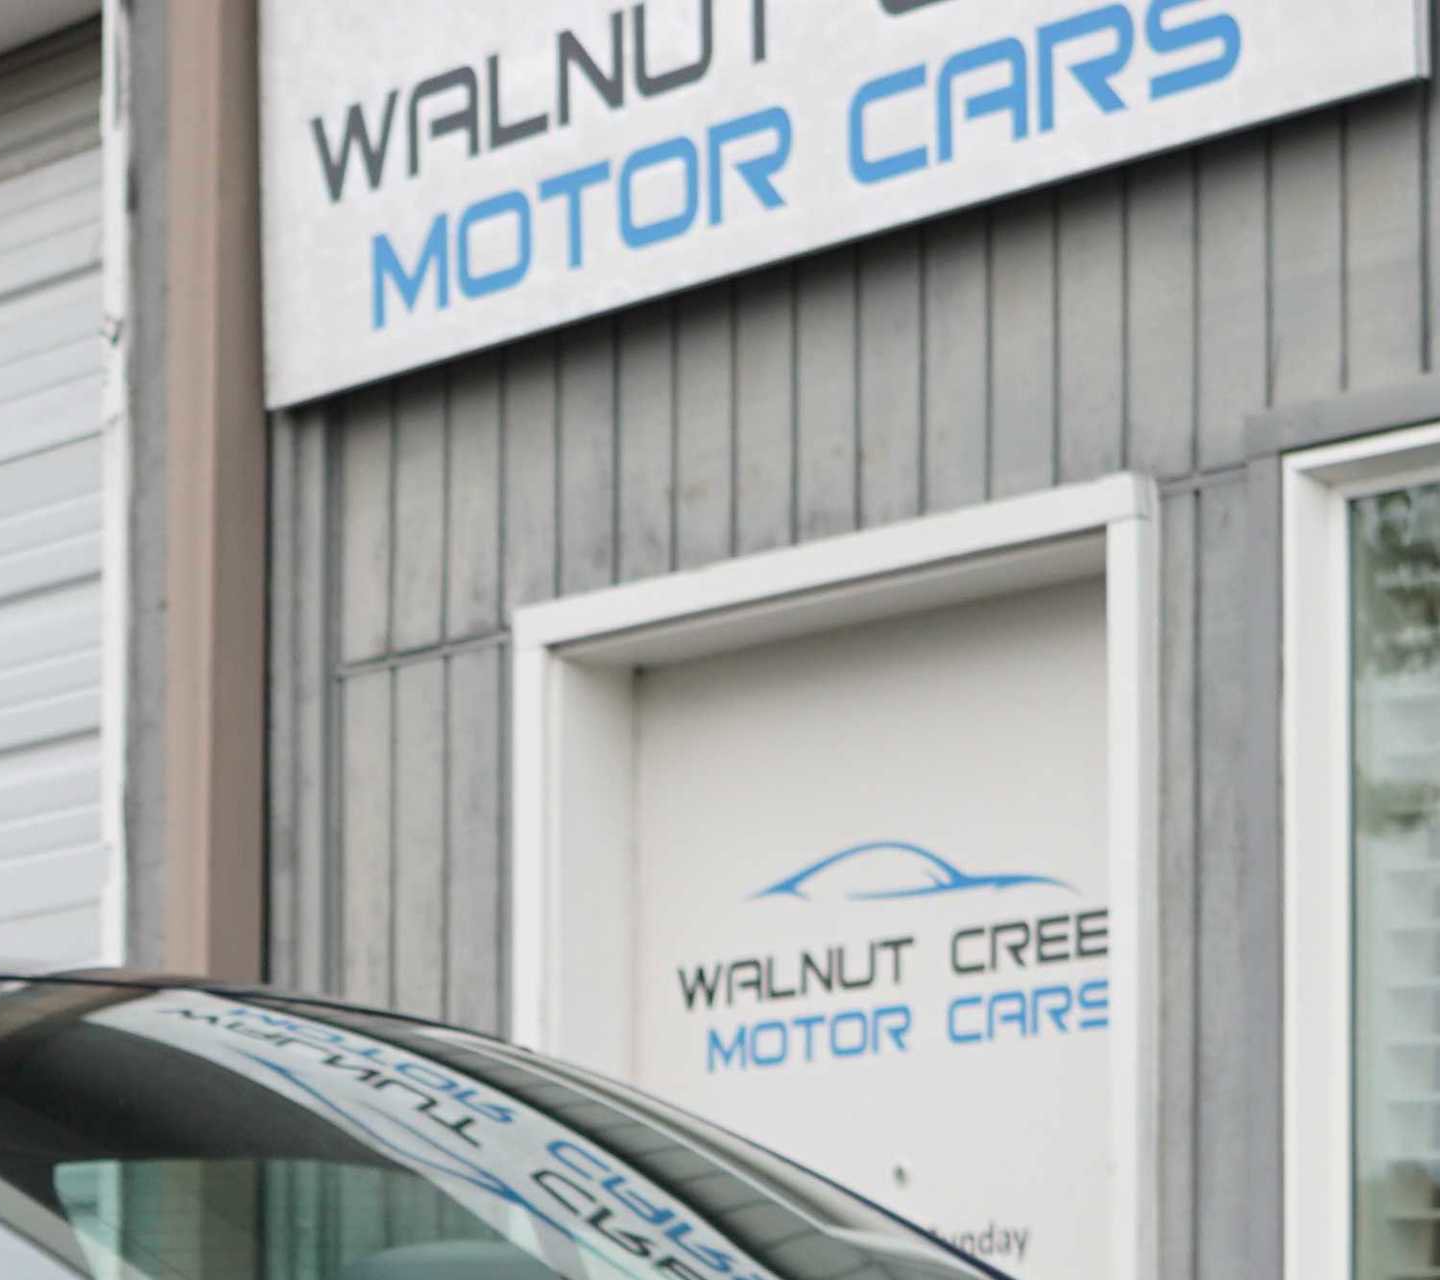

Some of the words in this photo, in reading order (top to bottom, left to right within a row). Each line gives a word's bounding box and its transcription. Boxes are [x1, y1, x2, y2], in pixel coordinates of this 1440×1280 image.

[371, 106, 793, 330] MOTOR
[848, 0, 1242, 185] CARS
[677, 936, 915, 1010] WALNUT
[951, 908, 1109, 975] CREE
[707, 1003, 913, 1072] MOTOR
[947, 977, 1110, 1045] CARS
